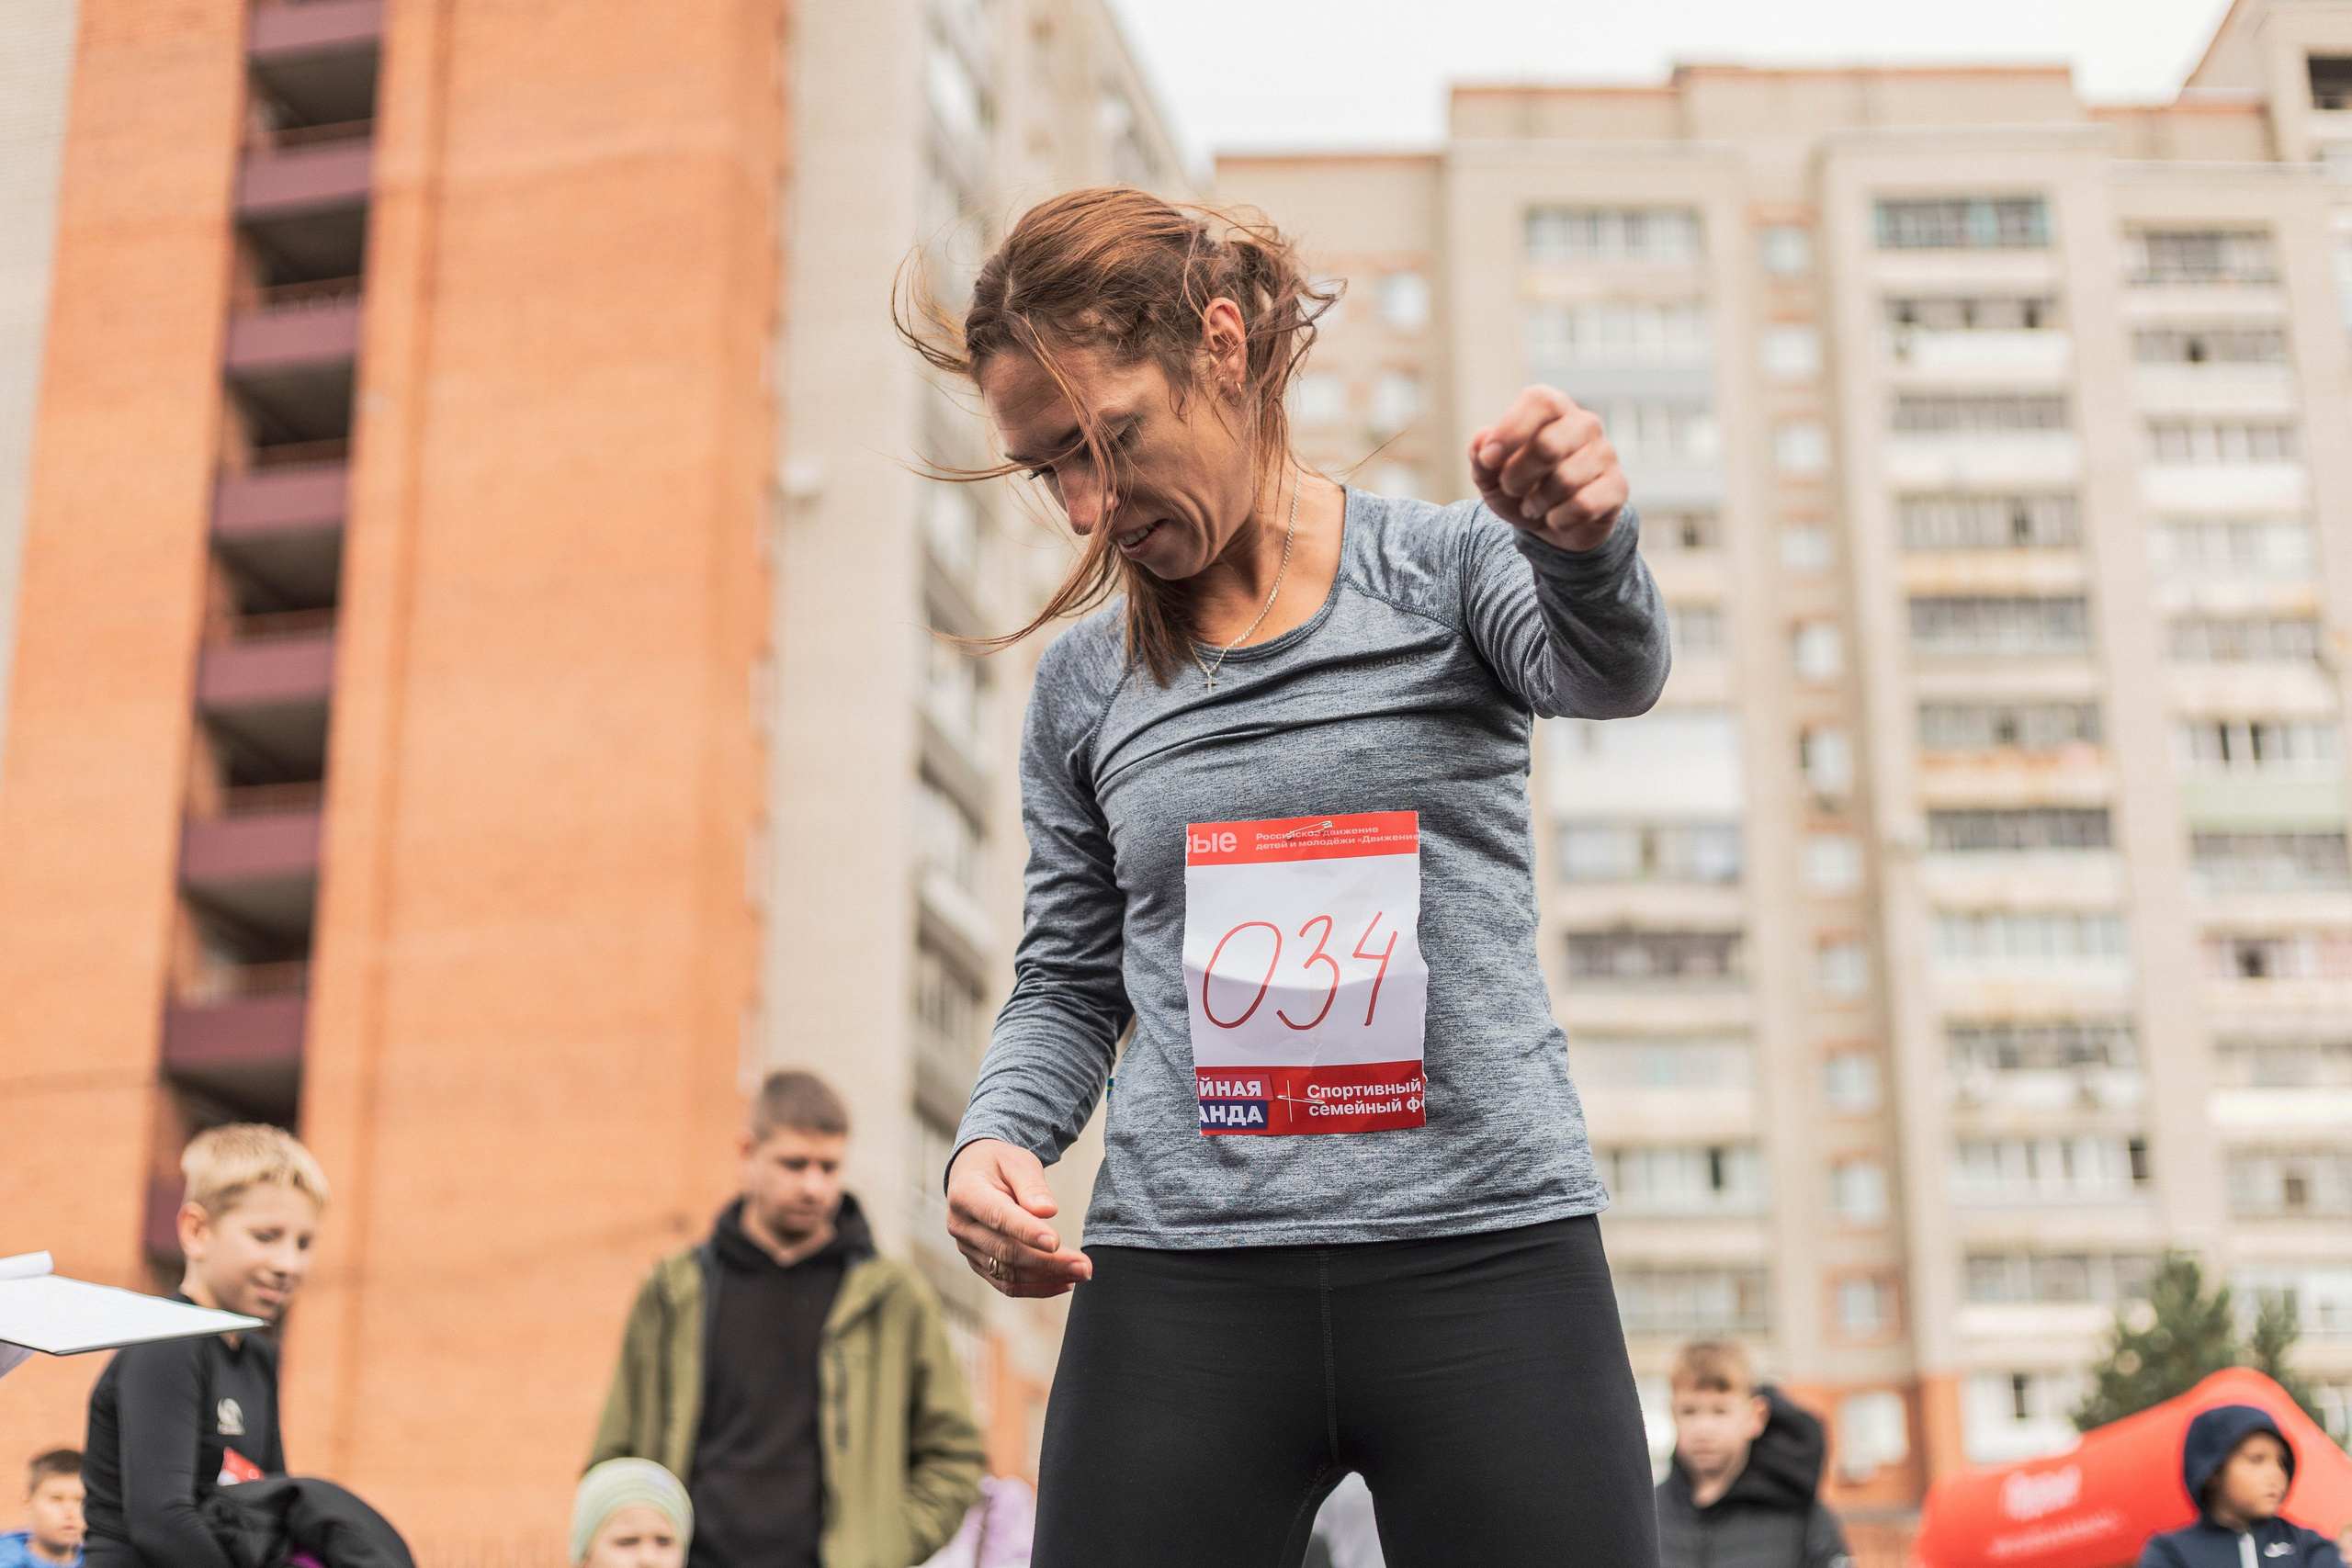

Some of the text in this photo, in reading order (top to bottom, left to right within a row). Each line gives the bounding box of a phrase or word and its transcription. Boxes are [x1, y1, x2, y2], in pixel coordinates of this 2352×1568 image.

[1256, 827, 1379, 840] Российское движение
[1256, 840, 1288, 851] детей
[1298, 837, 1355, 847] молодёжи
[1357, 833, 1419, 844] «Движение
[1203, 911, 1398, 1031] 034
[1199, 1077, 1262, 1097] ЙНАЯ
[1306, 1077, 1421, 1100] Спортивный
[1308, 1098, 1402, 1116] семейный
